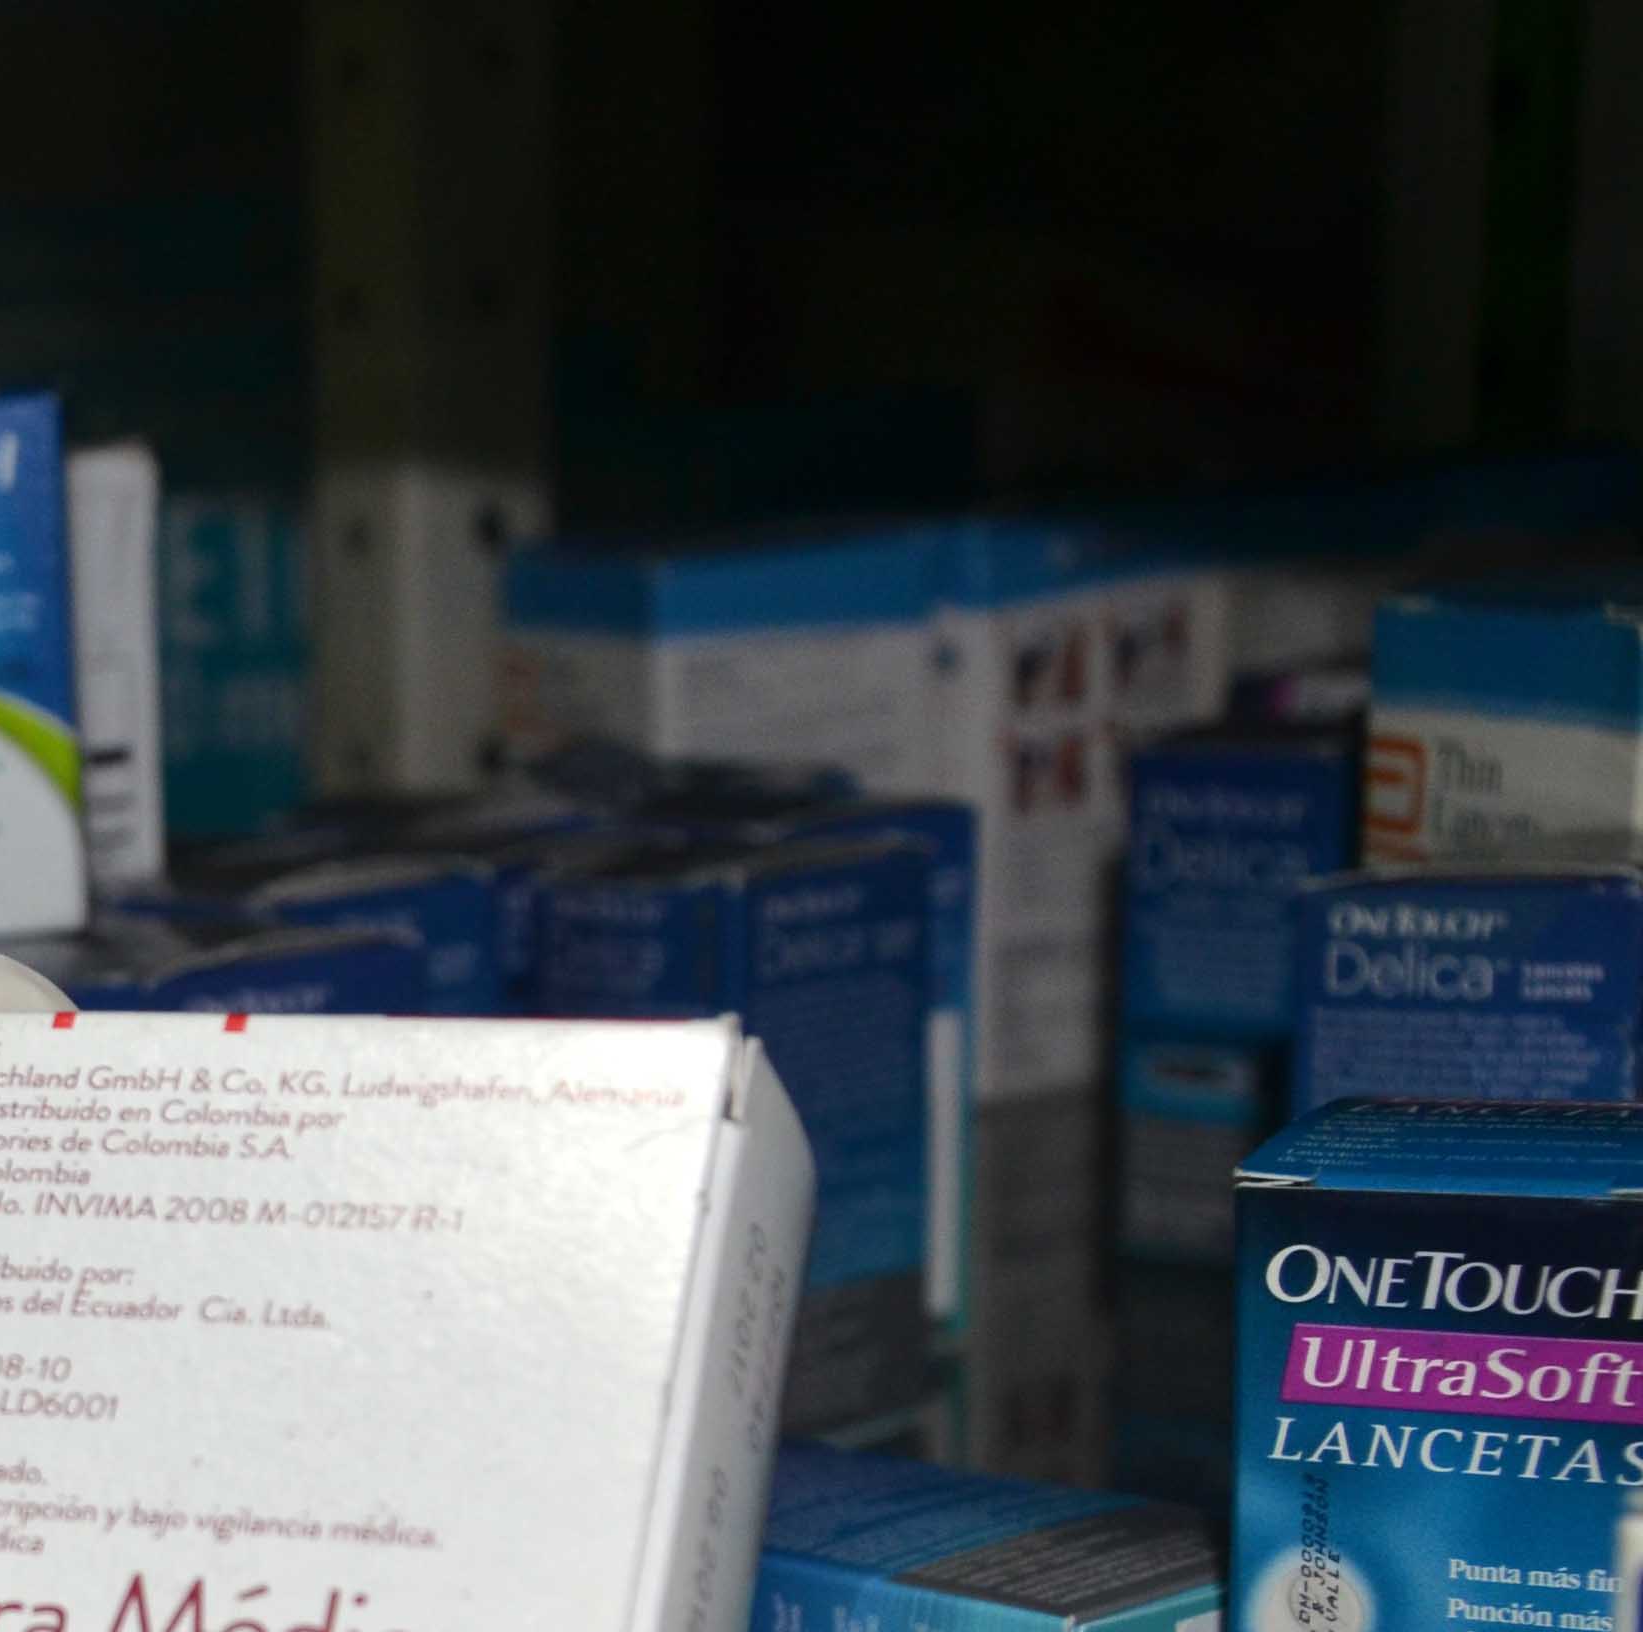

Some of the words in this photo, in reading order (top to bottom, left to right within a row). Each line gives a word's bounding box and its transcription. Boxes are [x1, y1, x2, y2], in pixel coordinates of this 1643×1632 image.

[1301, 1336, 1643, 1407] UltraSoft
[1267, 1416, 1643, 1487] LANCETAS
[1448, 1558, 1522, 1585] Punta
[1528, 1567, 1582, 1589] más
[1586, 1569, 1623, 1592] fin
[1447, 1597, 1554, 1628] Punción
[1559, 1610, 1614, 1632] más
